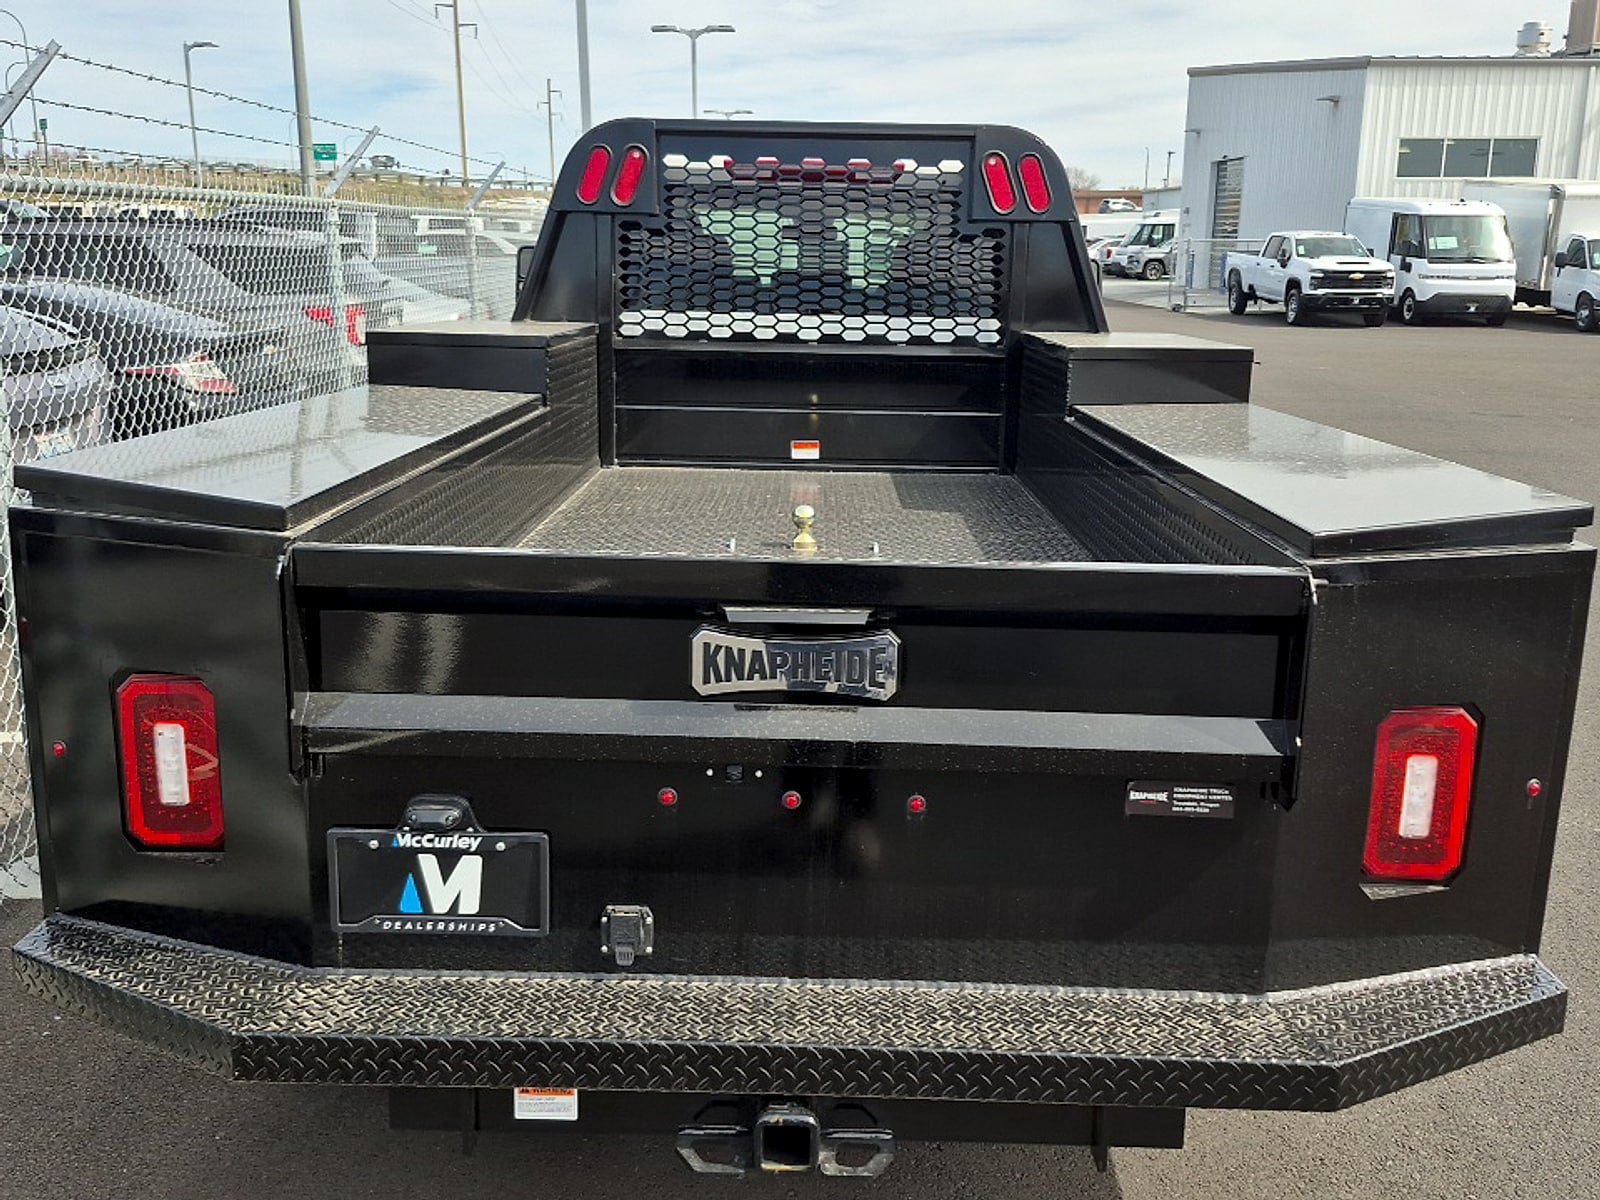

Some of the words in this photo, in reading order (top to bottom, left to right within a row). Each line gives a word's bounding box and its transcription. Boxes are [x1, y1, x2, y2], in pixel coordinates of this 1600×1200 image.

[702, 642, 888, 689] KNAPHEIDE
[393, 833, 482, 851] McCurley
[400, 853, 483, 914] M
[383, 921, 496, 932] DEALERSHIPS
